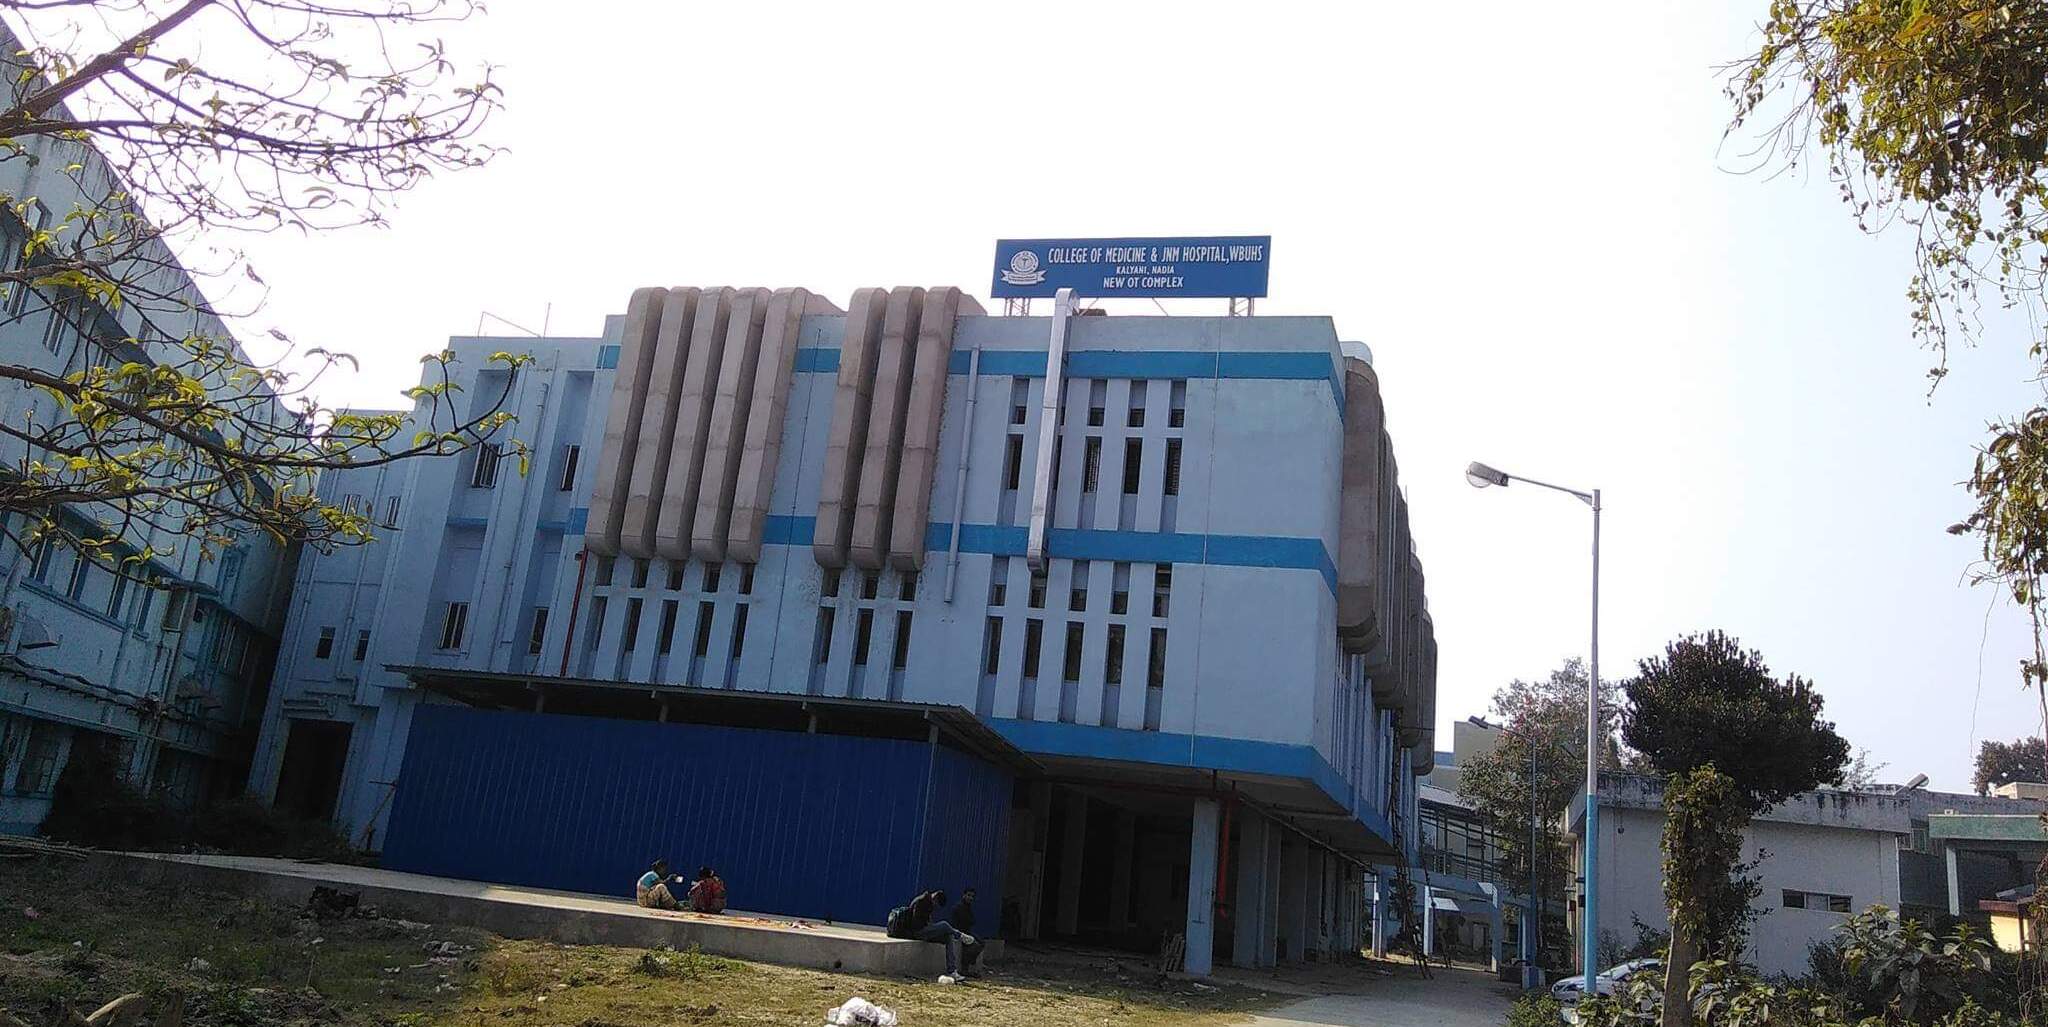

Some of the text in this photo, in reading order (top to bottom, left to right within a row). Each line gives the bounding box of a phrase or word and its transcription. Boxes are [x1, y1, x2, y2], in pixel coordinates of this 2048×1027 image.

[1048, 247, 1088, 263] COLLEGE
[1090, 247, 1102, 263] OF
[1105, 246, 1146, 262] MEDICINE
[1151, 247, 1158, 262] &
[1161, 246, 1180, 262] JNM
[1116, 265, 1175, 275] KALYANI, NADIA
[1103, 276, 1184, 288] NEW OT COMPLEX
